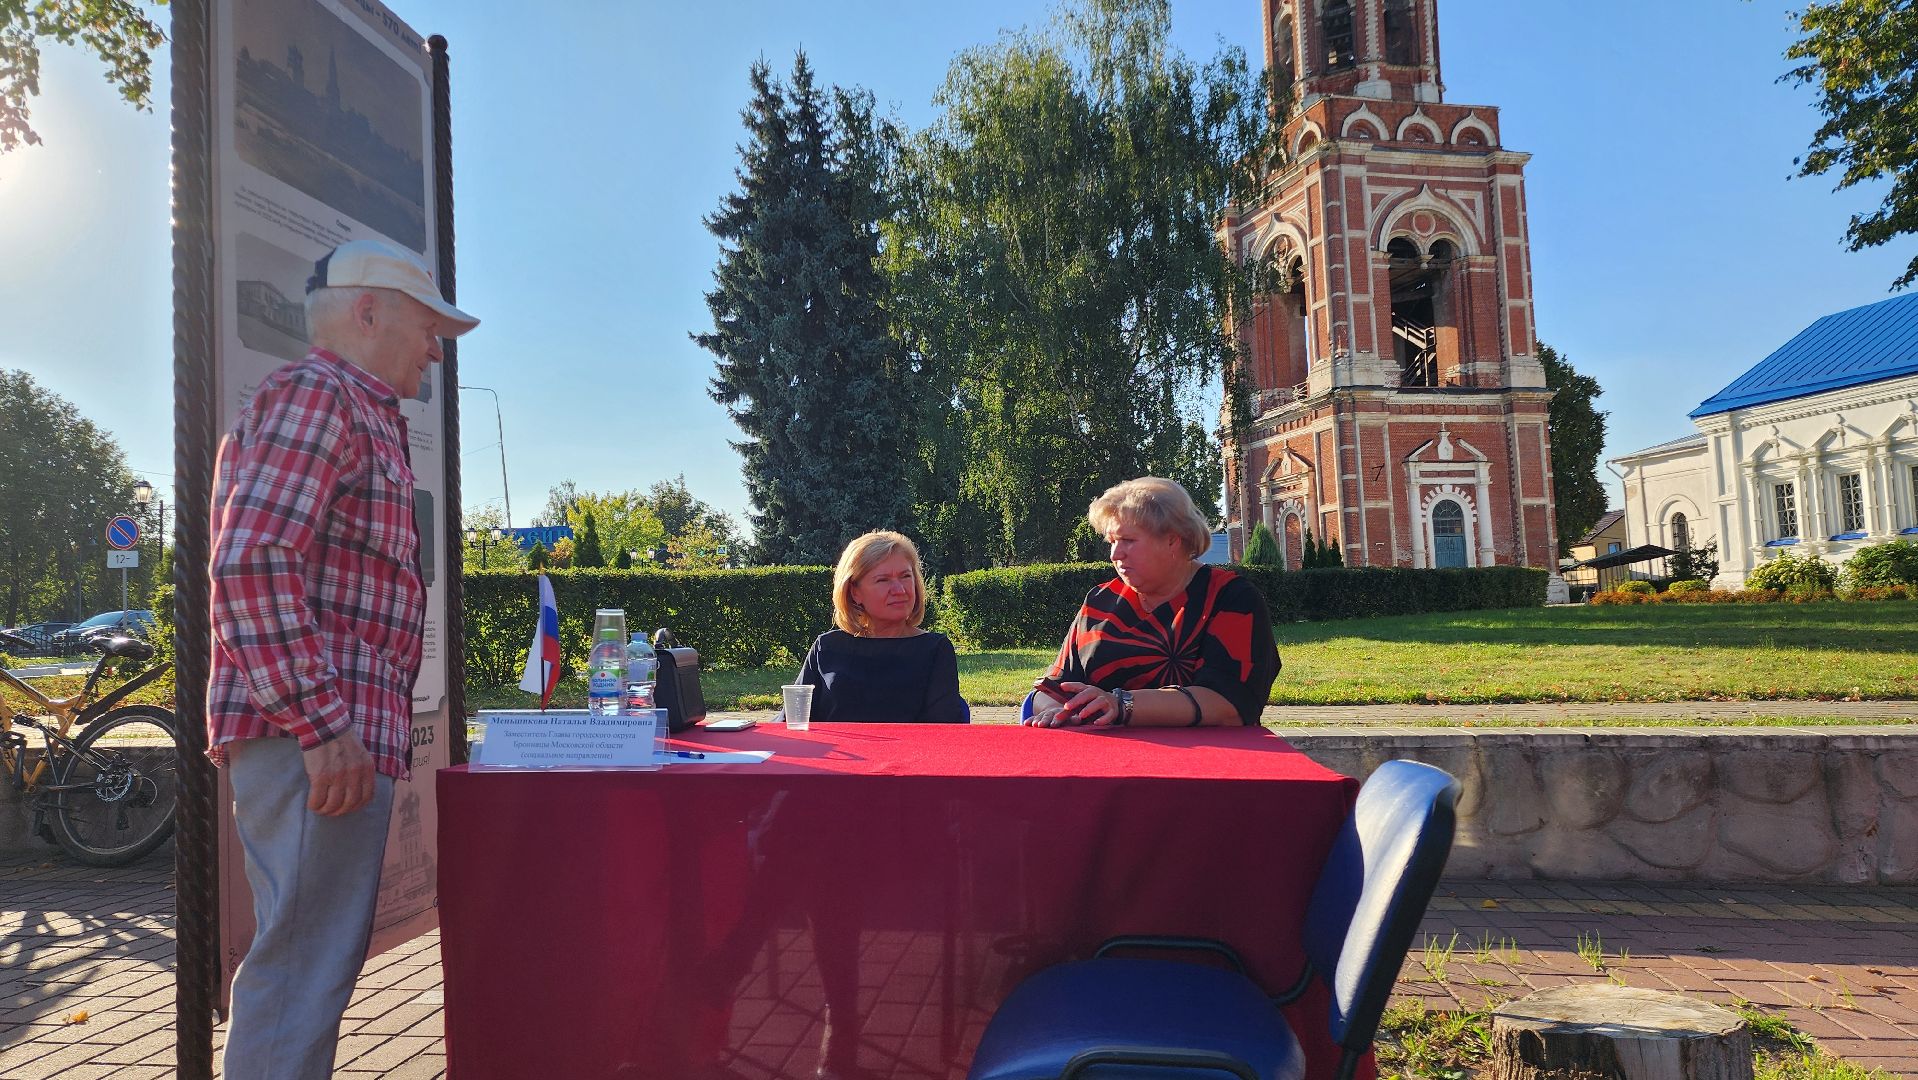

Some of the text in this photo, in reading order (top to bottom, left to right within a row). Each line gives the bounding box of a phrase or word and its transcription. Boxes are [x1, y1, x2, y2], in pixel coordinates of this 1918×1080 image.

[382, 12, 399, 35] 570
[550, 717, 587, 726] Наталья
[589, 718, 653, 727] Владимировна
[411, 725, 434, 747] 023
